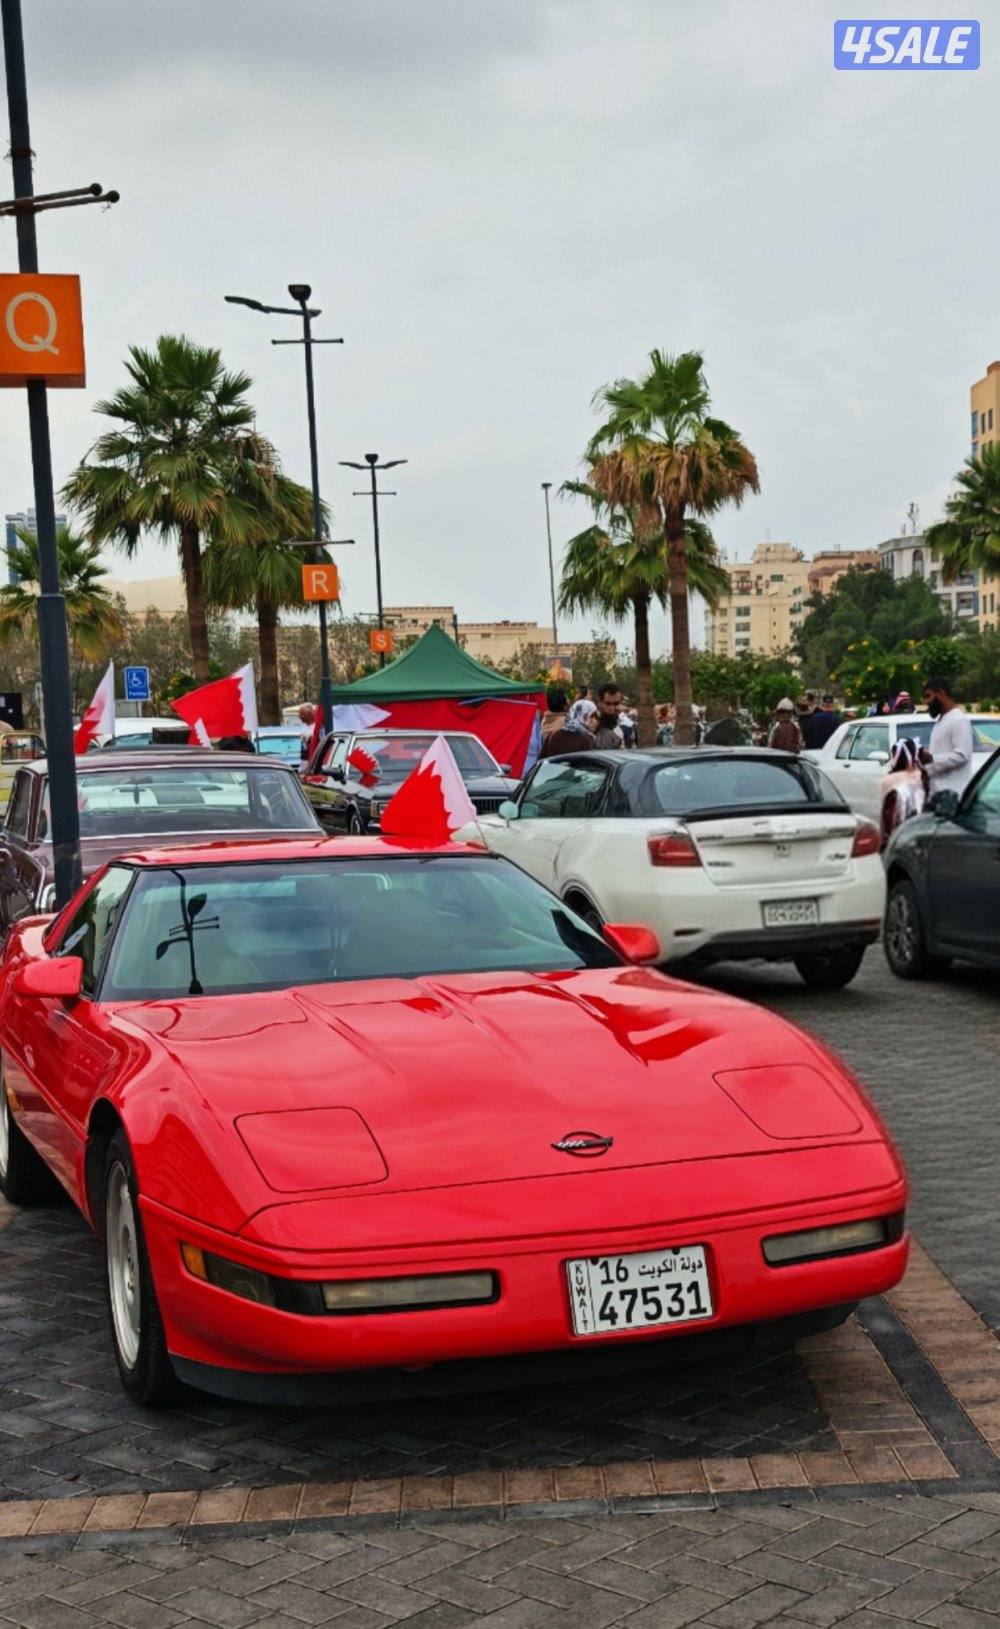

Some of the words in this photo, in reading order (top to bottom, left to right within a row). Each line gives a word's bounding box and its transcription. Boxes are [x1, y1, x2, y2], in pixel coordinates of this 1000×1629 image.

[6, 291, 59, 356] Q
[311, 571, 330, 594] R
[376, 635, 387, 649] S
[599, 1258, 629, 1285] 16
[638, 1258, 677, 1278] الكويت
[680, 1256, 703, 1273] دولة
[575, 1263, 589, 1331] KUWAIT
[598, 1280, 707, 1326] 47531
